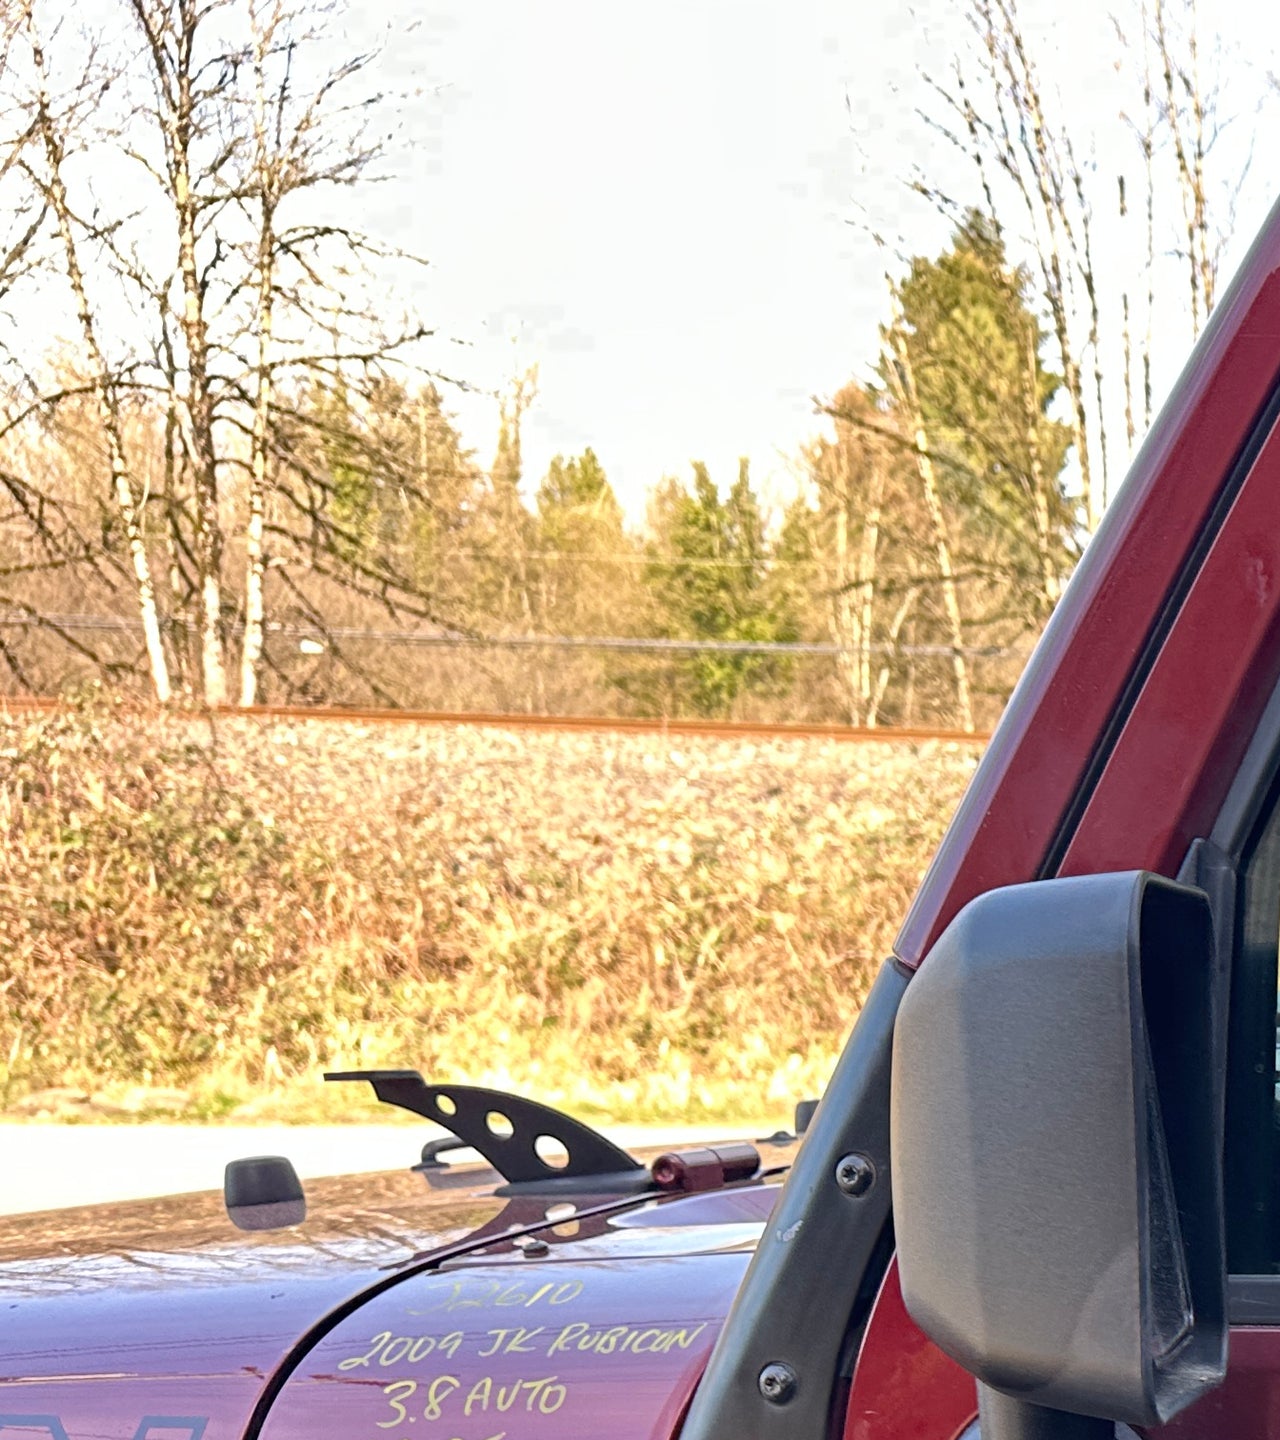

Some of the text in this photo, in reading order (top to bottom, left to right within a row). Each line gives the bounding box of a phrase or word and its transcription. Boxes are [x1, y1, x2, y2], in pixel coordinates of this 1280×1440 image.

[406, 1279, 584, 1316] J2610
[338, 1322, 708, 1371] 2009 JK RUBICON
[376, 1375, 567, 1429] 3.8 AUTO
